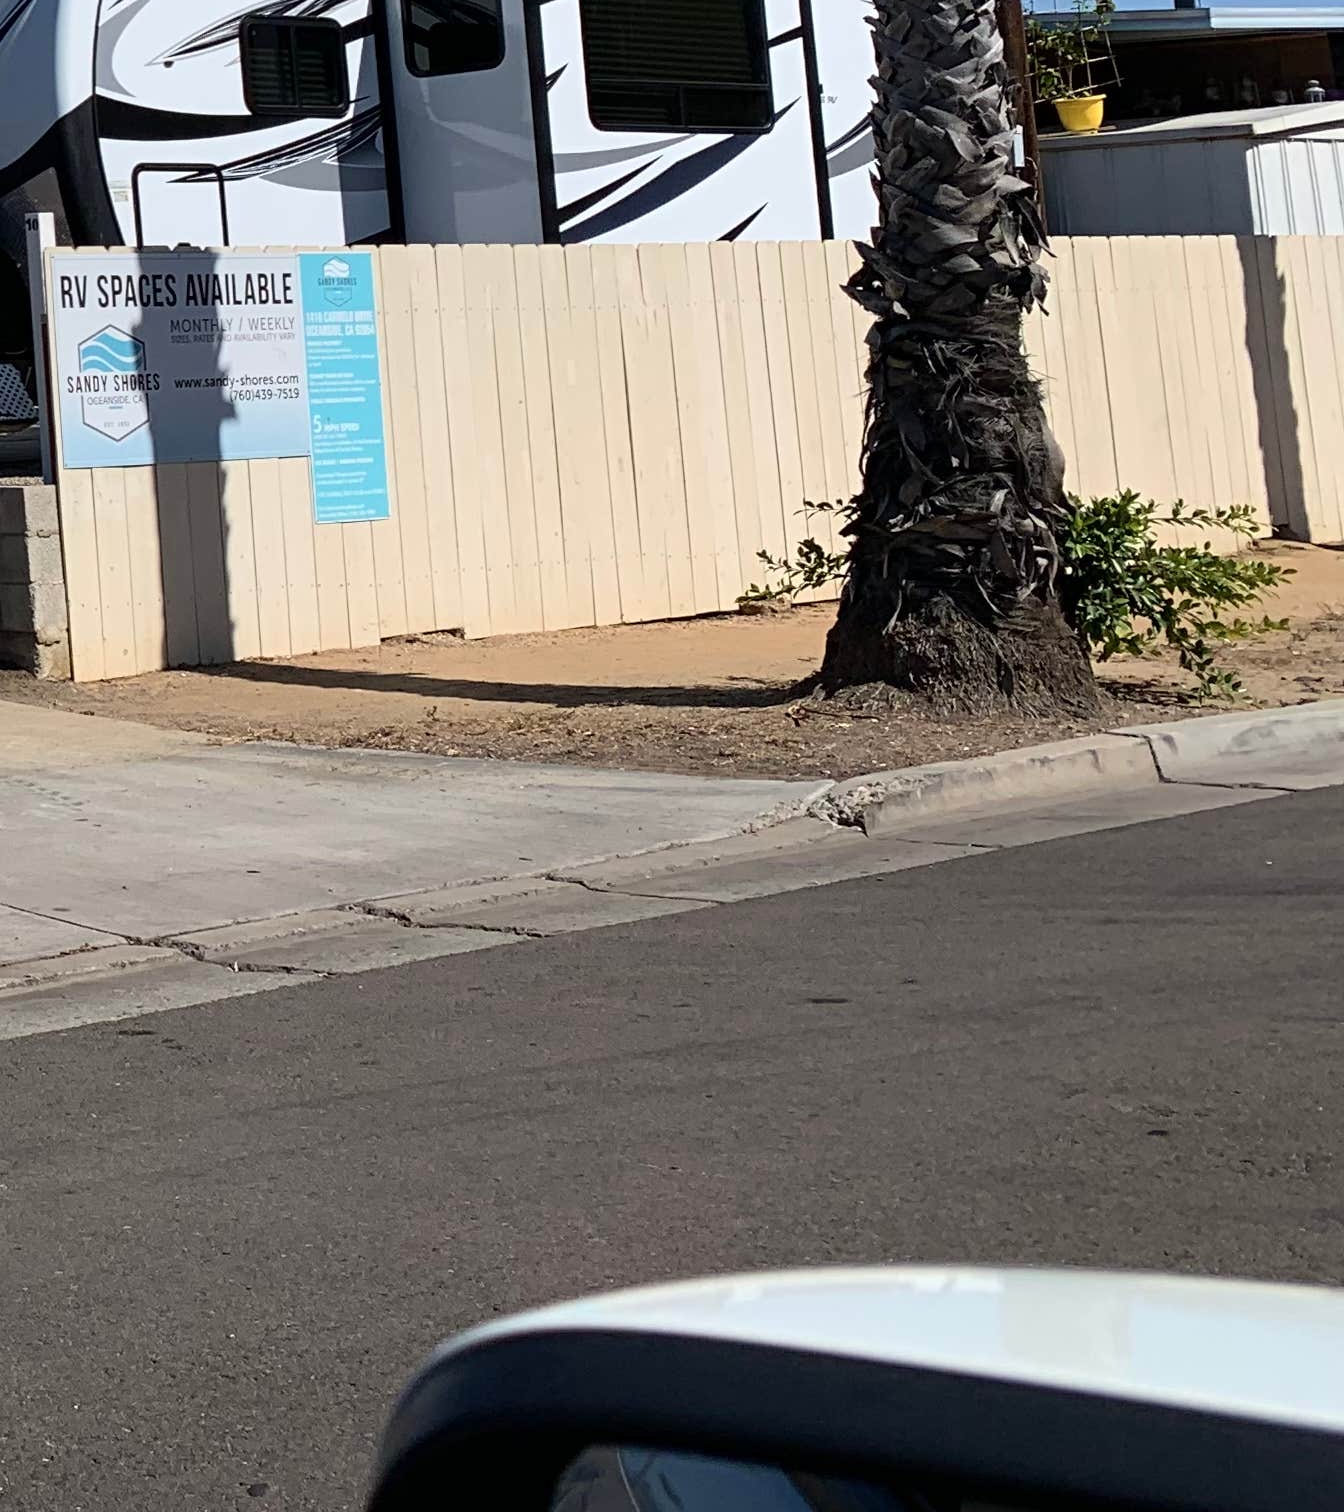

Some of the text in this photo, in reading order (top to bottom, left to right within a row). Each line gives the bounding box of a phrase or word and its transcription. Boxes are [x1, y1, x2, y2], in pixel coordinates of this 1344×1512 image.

[25, 218, 39, 232] 10
[60, 273, 293, 308] RV SPACES AVAILABLE
[169, 318, 233, 333] MONTHLY
[248, 317, 295, 331] WEEKLY
[234, 332, 278, 342] AVAILABILITY
[67, 373, 160, 393] SANDY SHORES
[174, 374, 300, 389] www.sandy-shores.com
[132, 394, 145, 404] CA
[229, 388, 300, 403] (760)439-7519
[313, 414, 322, 433] 5
